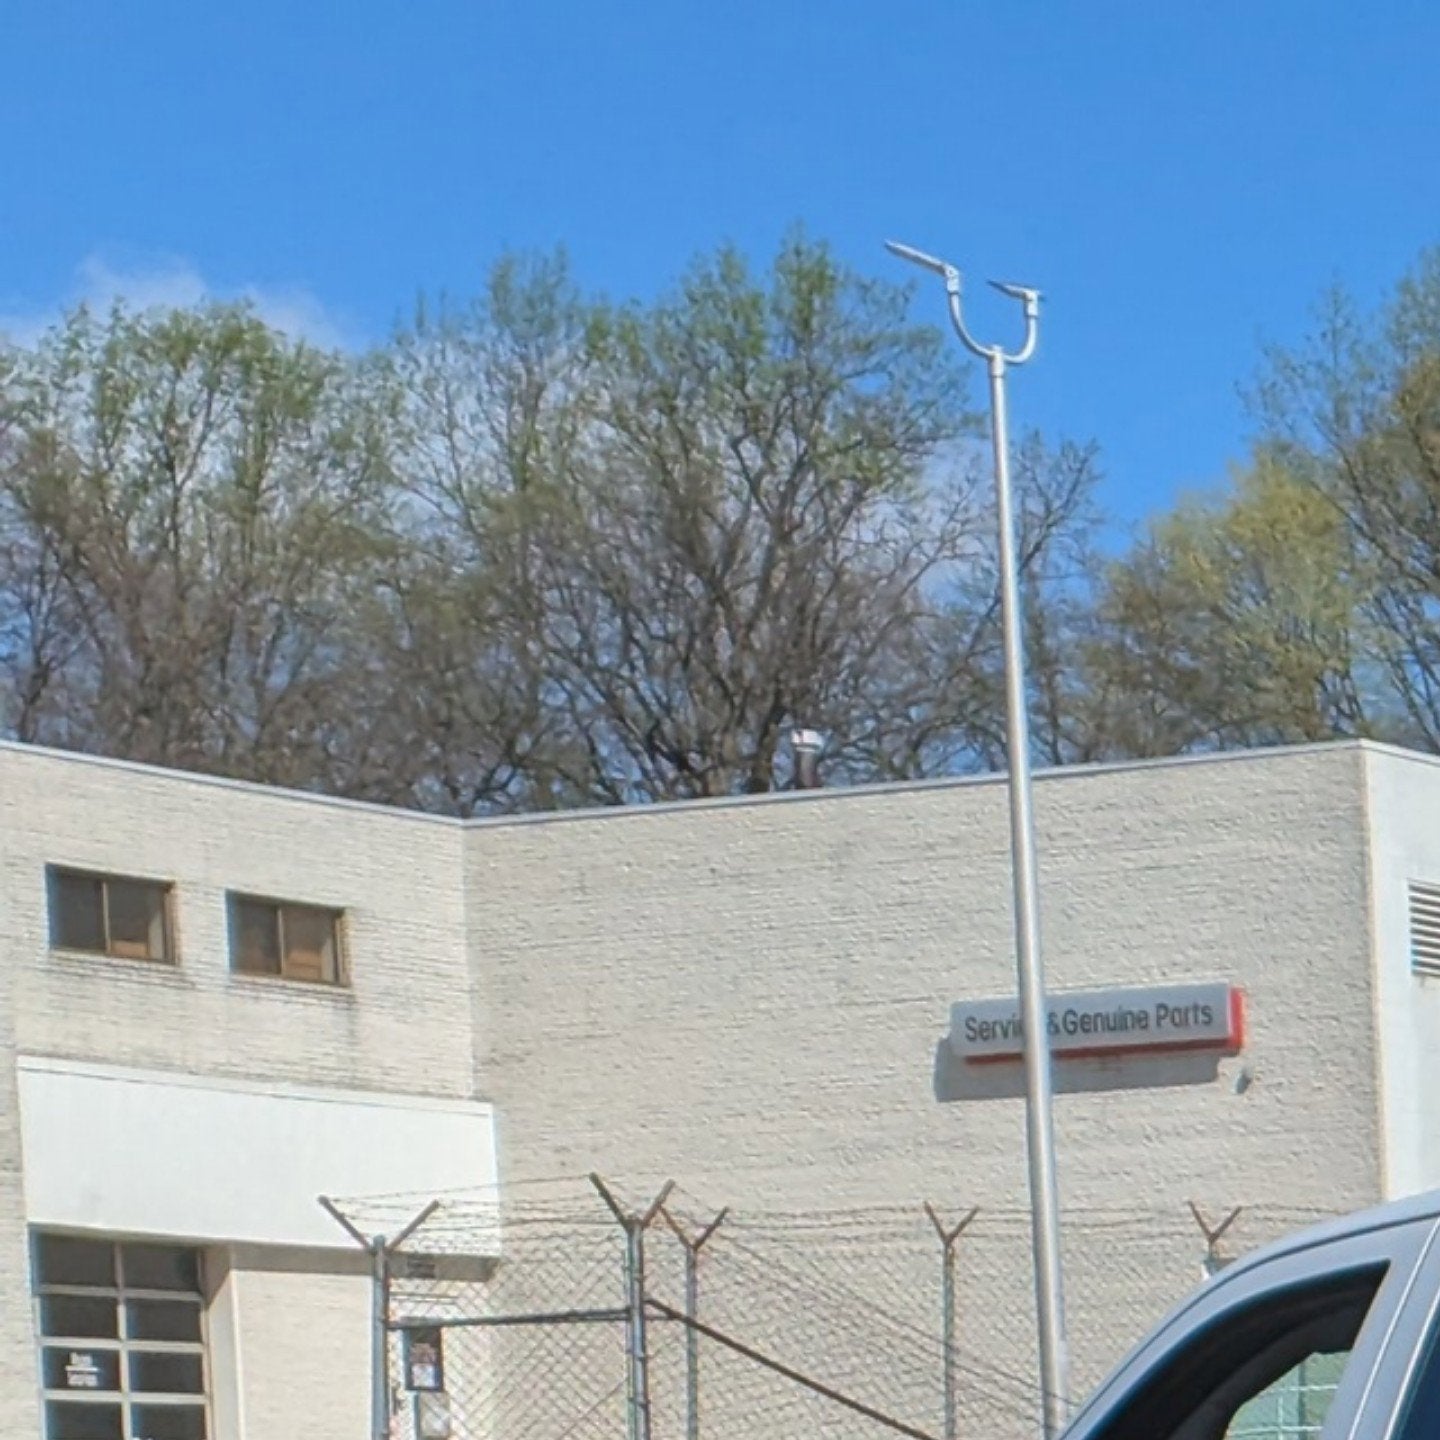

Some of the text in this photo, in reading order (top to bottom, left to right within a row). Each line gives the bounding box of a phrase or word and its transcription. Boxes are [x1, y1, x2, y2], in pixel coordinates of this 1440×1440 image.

[965, 1012, 1023, 1042] Servi
[1062, 1004, 1149, 1035] Genuine
[1155, 1002, 1213, 1028] Parts
